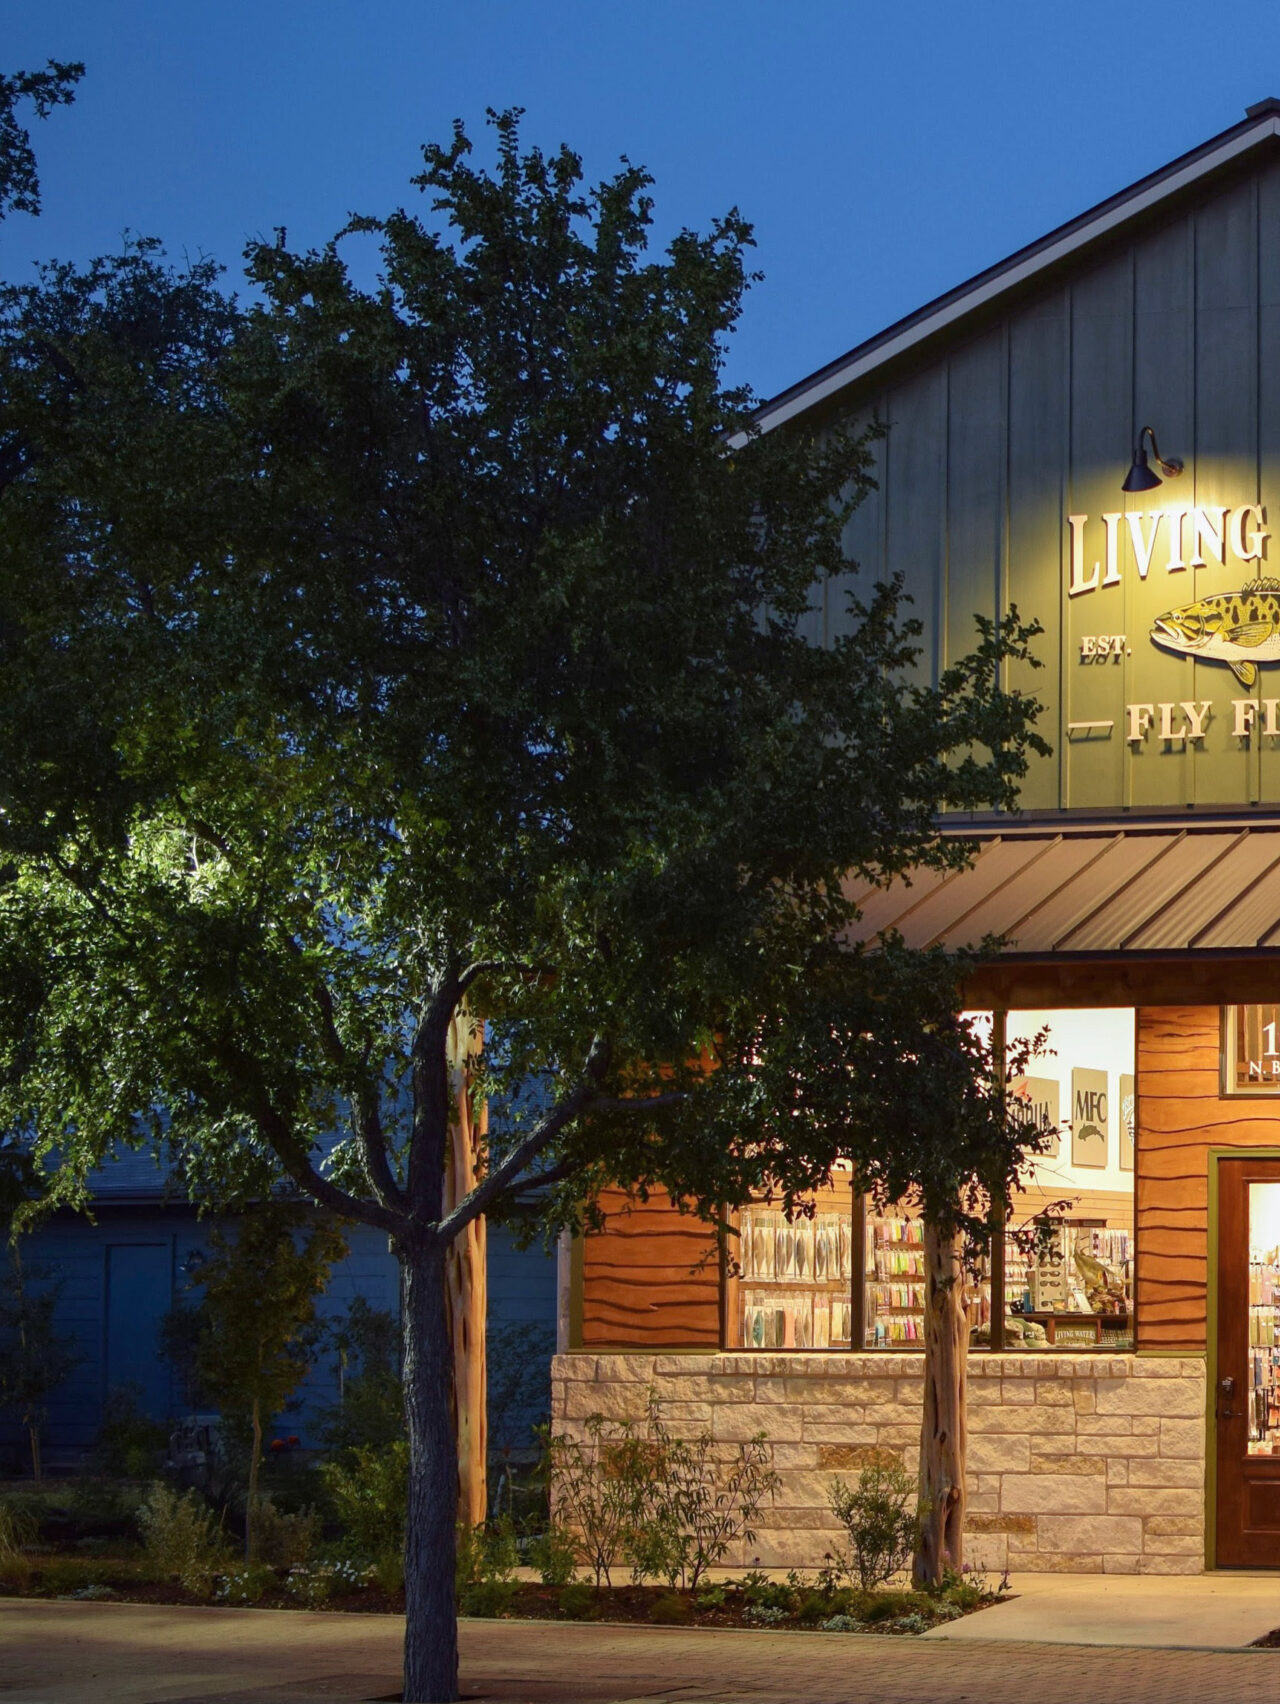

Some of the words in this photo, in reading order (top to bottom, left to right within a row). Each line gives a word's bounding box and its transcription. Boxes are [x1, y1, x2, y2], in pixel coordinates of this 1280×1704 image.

[1068, 504, 1270, 596] LIVING
[1081, 635, 1132, 657] EST.
[1127, 701, 1213, 741] FLY
[1250, 1060, 1266, 1075] N.
[1075, 1090, 1107, 1123] MFC
[1054, 1330, 1074, 1340] LIVING
[1075, 1330, 1096, 1340] WATERS
